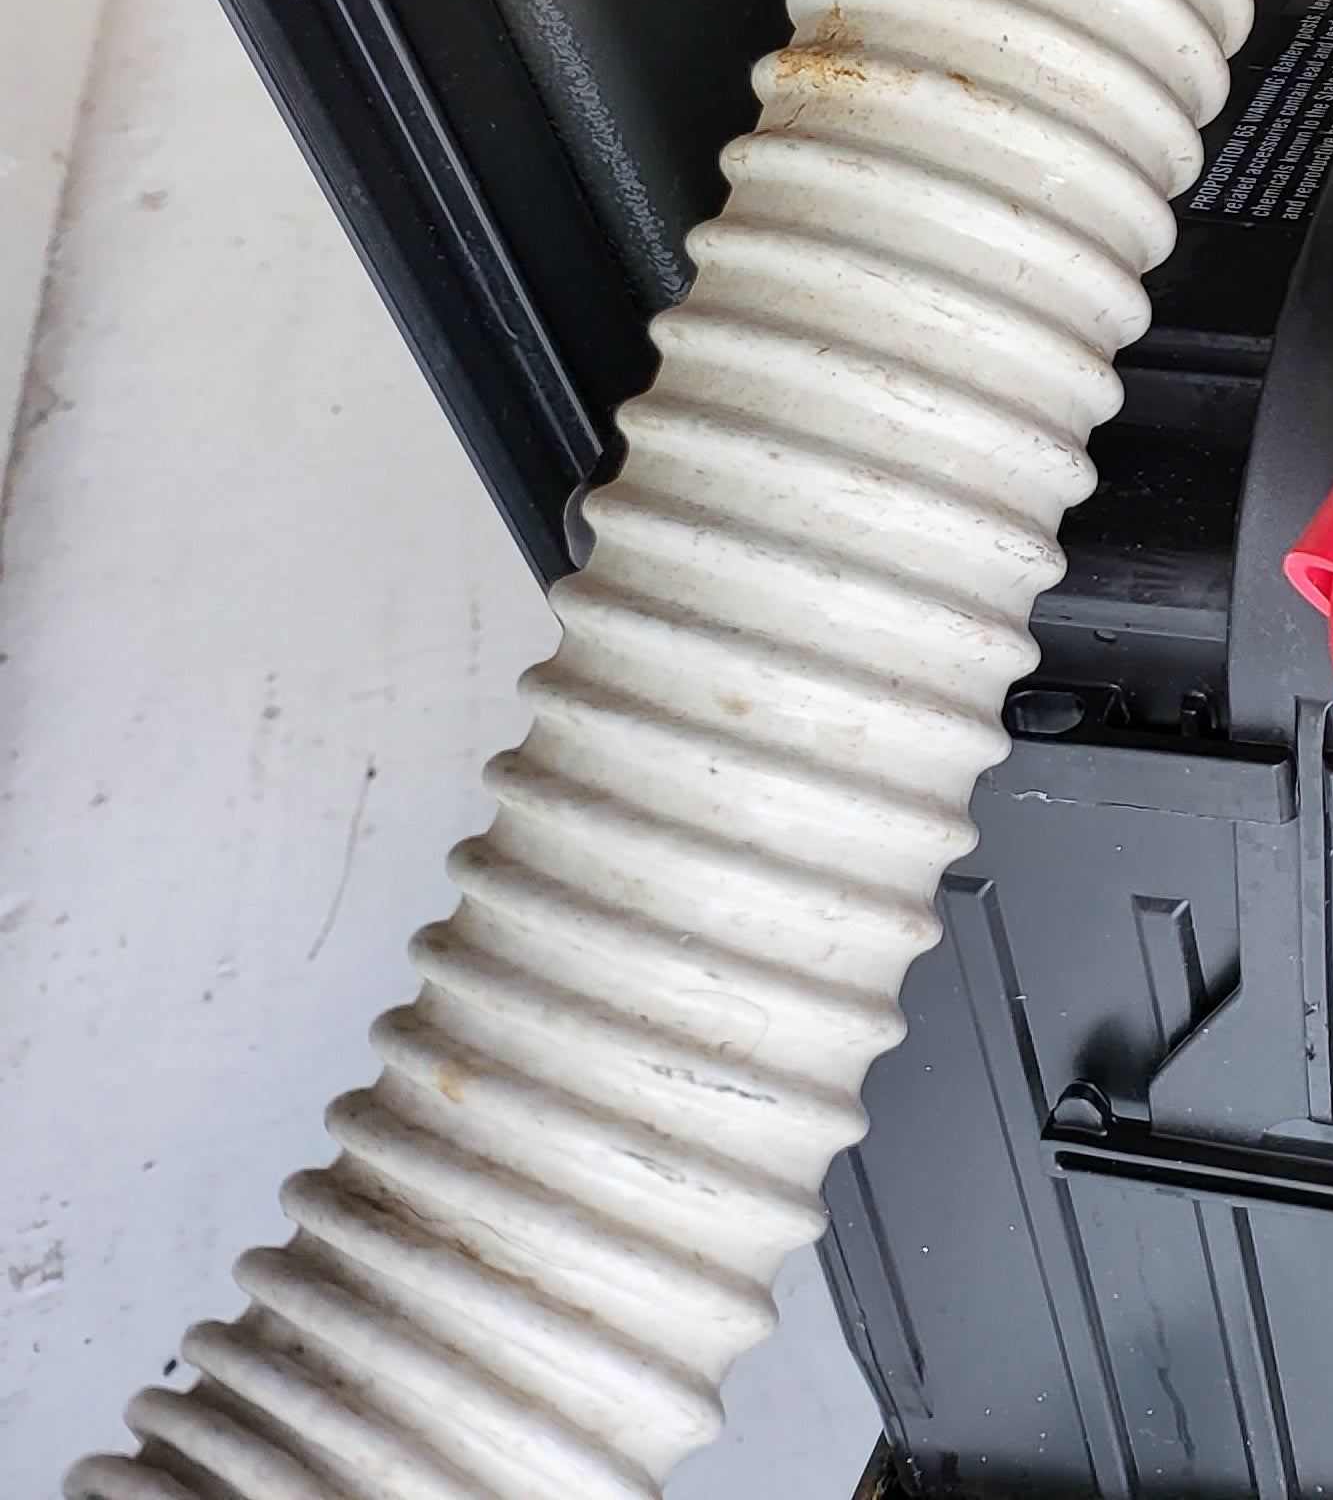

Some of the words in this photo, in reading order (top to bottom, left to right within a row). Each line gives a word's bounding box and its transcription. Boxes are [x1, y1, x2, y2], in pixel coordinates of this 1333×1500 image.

[1272, 40, 1311, 73] Battery
[1241, 75, 1289, 122] WARNING:
[1303, 101, 1330, 118] the
[1223, 176, 1258, 213] related
[1245, 117, 1292, 175] accessories
[1279, 80, 1312, 116] contain
[1296, 60, 1325, 81] lead
[1233, 124, 1258, 139] 65
[1296, 117, 1321, 130] to
[1278, 131, 1313, 163] known
[1189, 138, 1249, 211] PROPOSITION
[1252, 163, 1295, 217] chemicals
[1282, 199, 1306, 220] and
